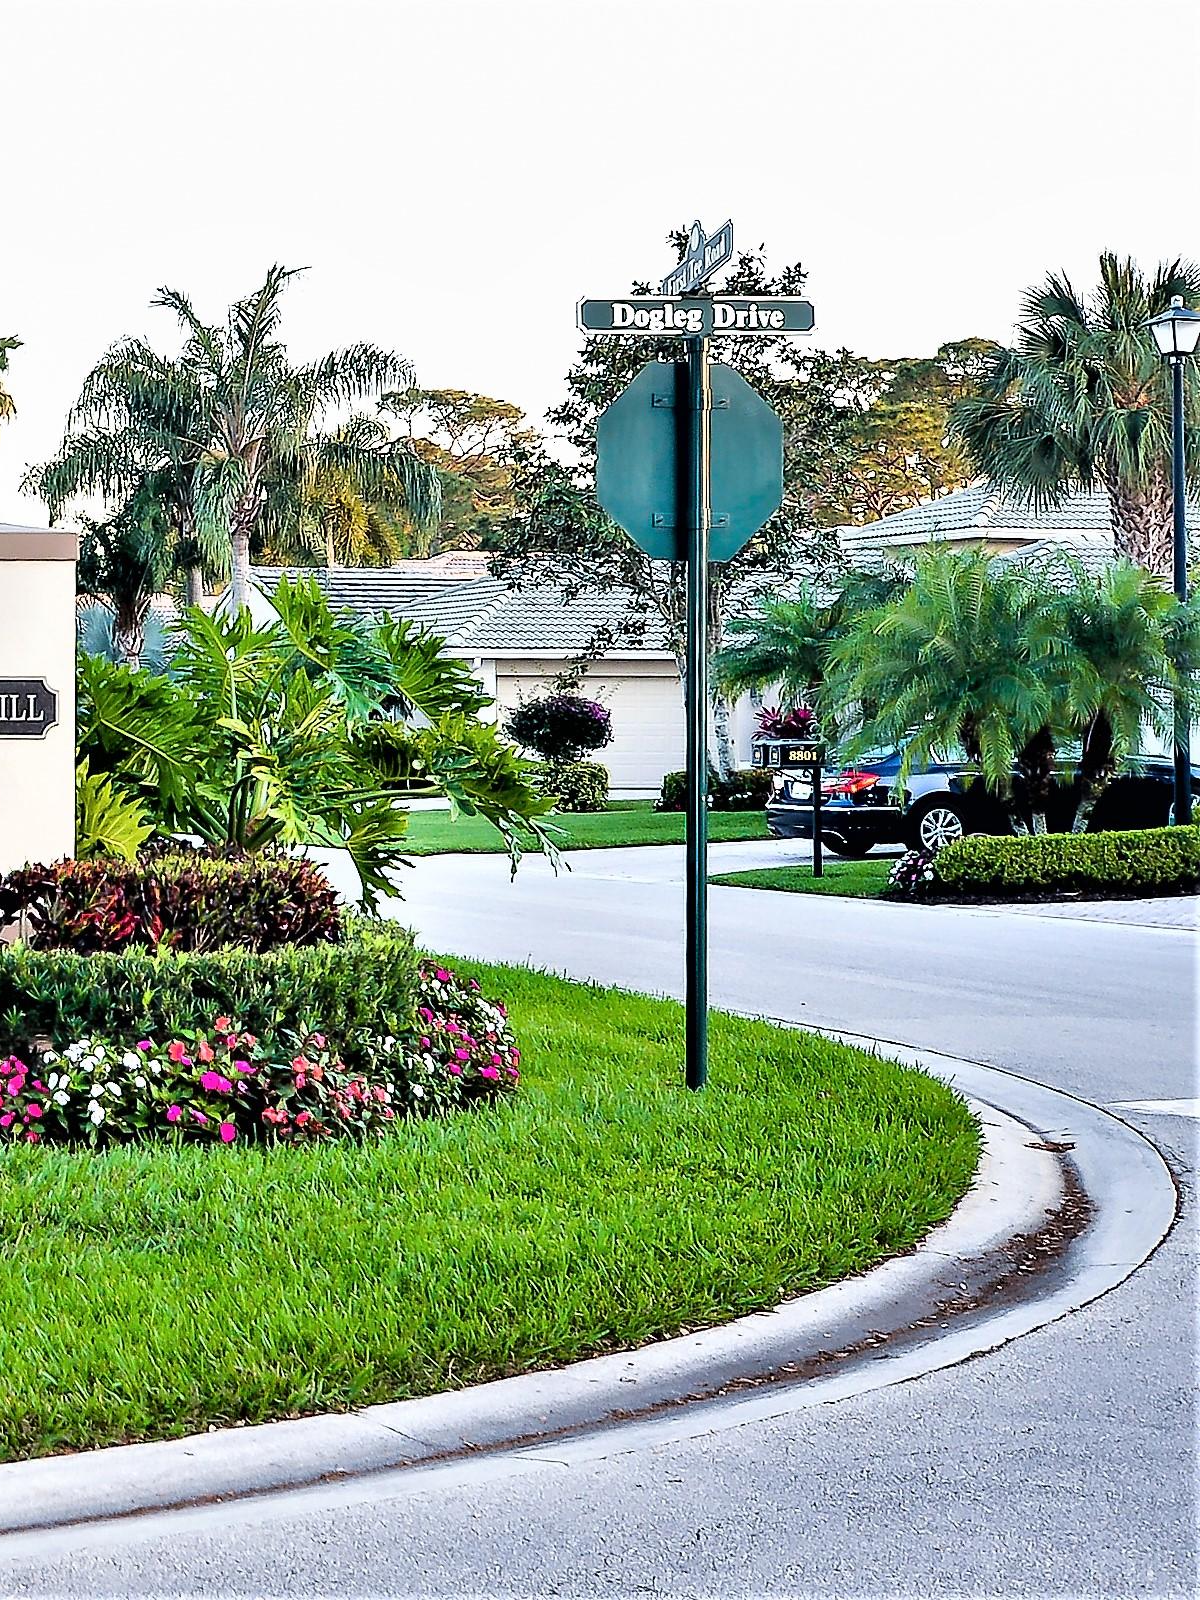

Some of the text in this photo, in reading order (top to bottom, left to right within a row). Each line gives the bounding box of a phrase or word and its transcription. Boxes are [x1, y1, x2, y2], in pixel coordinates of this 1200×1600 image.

[704, 232, 726, 270] Road
[612, 302, 785, 332] Dogleg Drive
[788, 750, 817, 761] 8801
